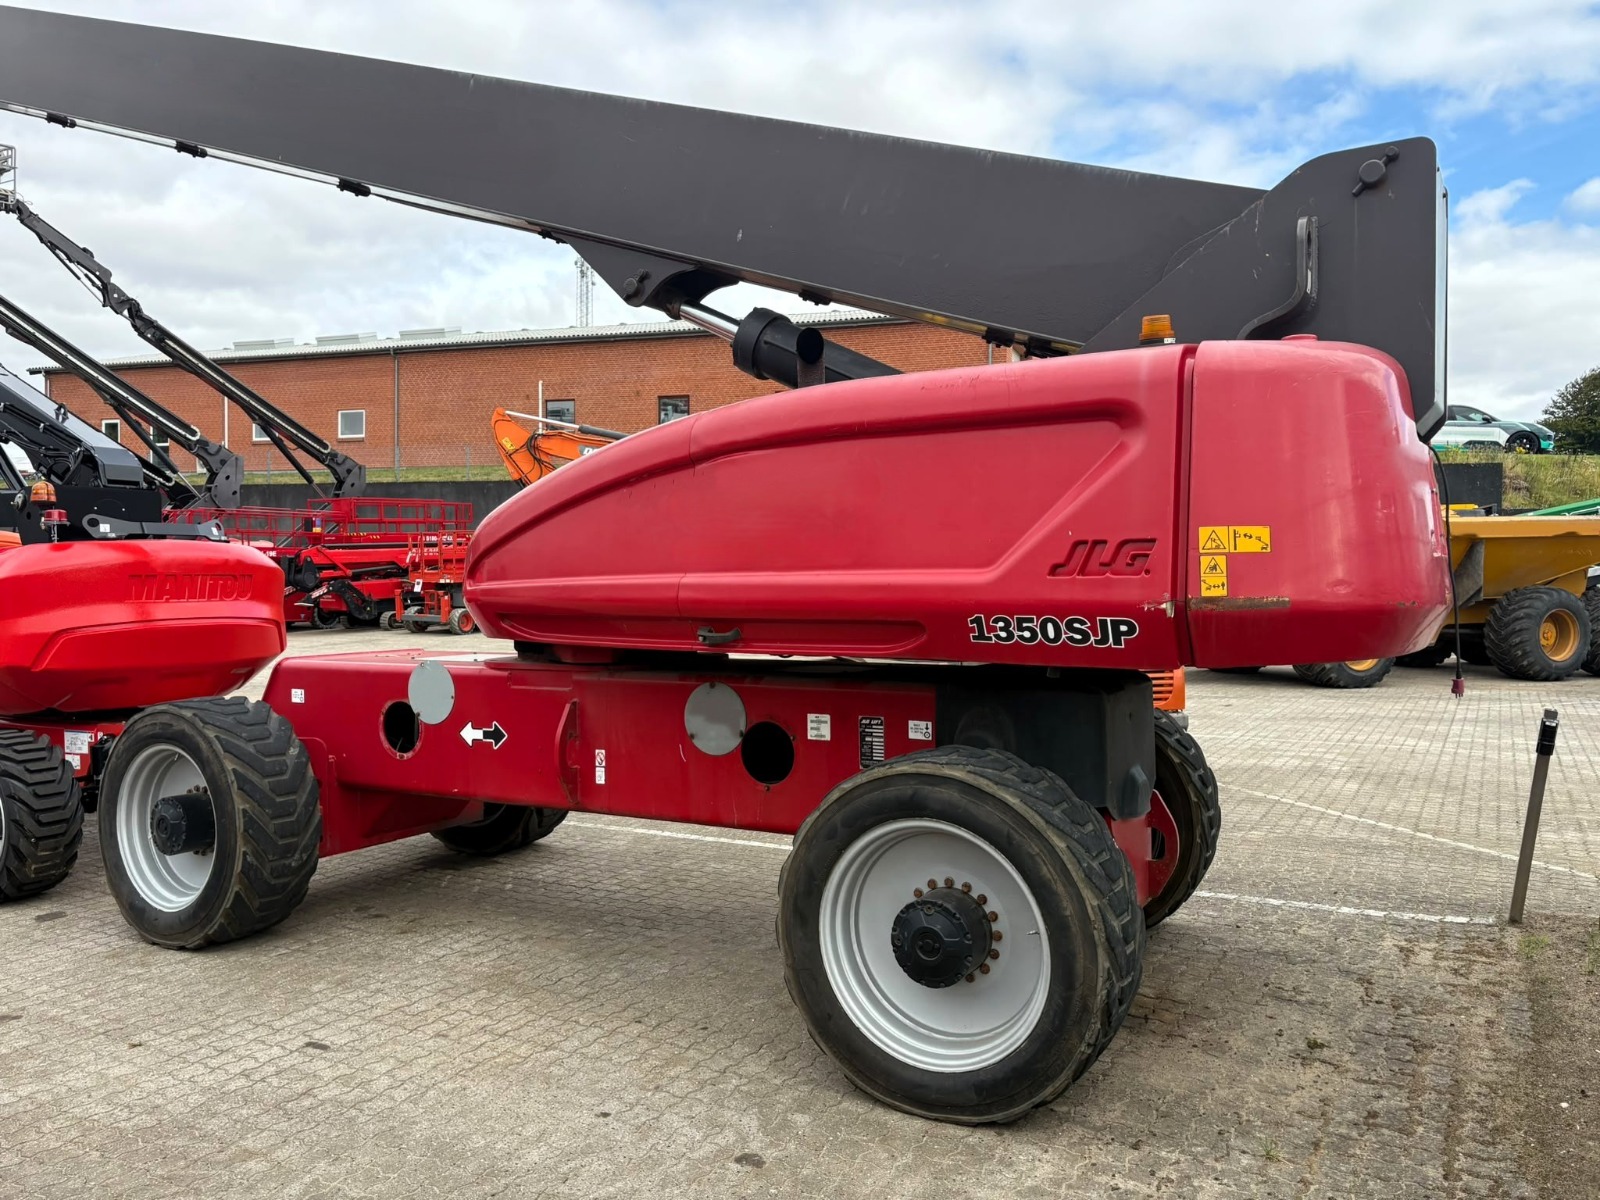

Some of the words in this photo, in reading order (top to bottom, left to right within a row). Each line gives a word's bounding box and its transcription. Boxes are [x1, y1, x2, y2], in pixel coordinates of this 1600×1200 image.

[1047, 538, 1157, 578] JLG
[124, 573, 253, 602] MANITOU
[968, 614, 1139, 648] 1350SJP
